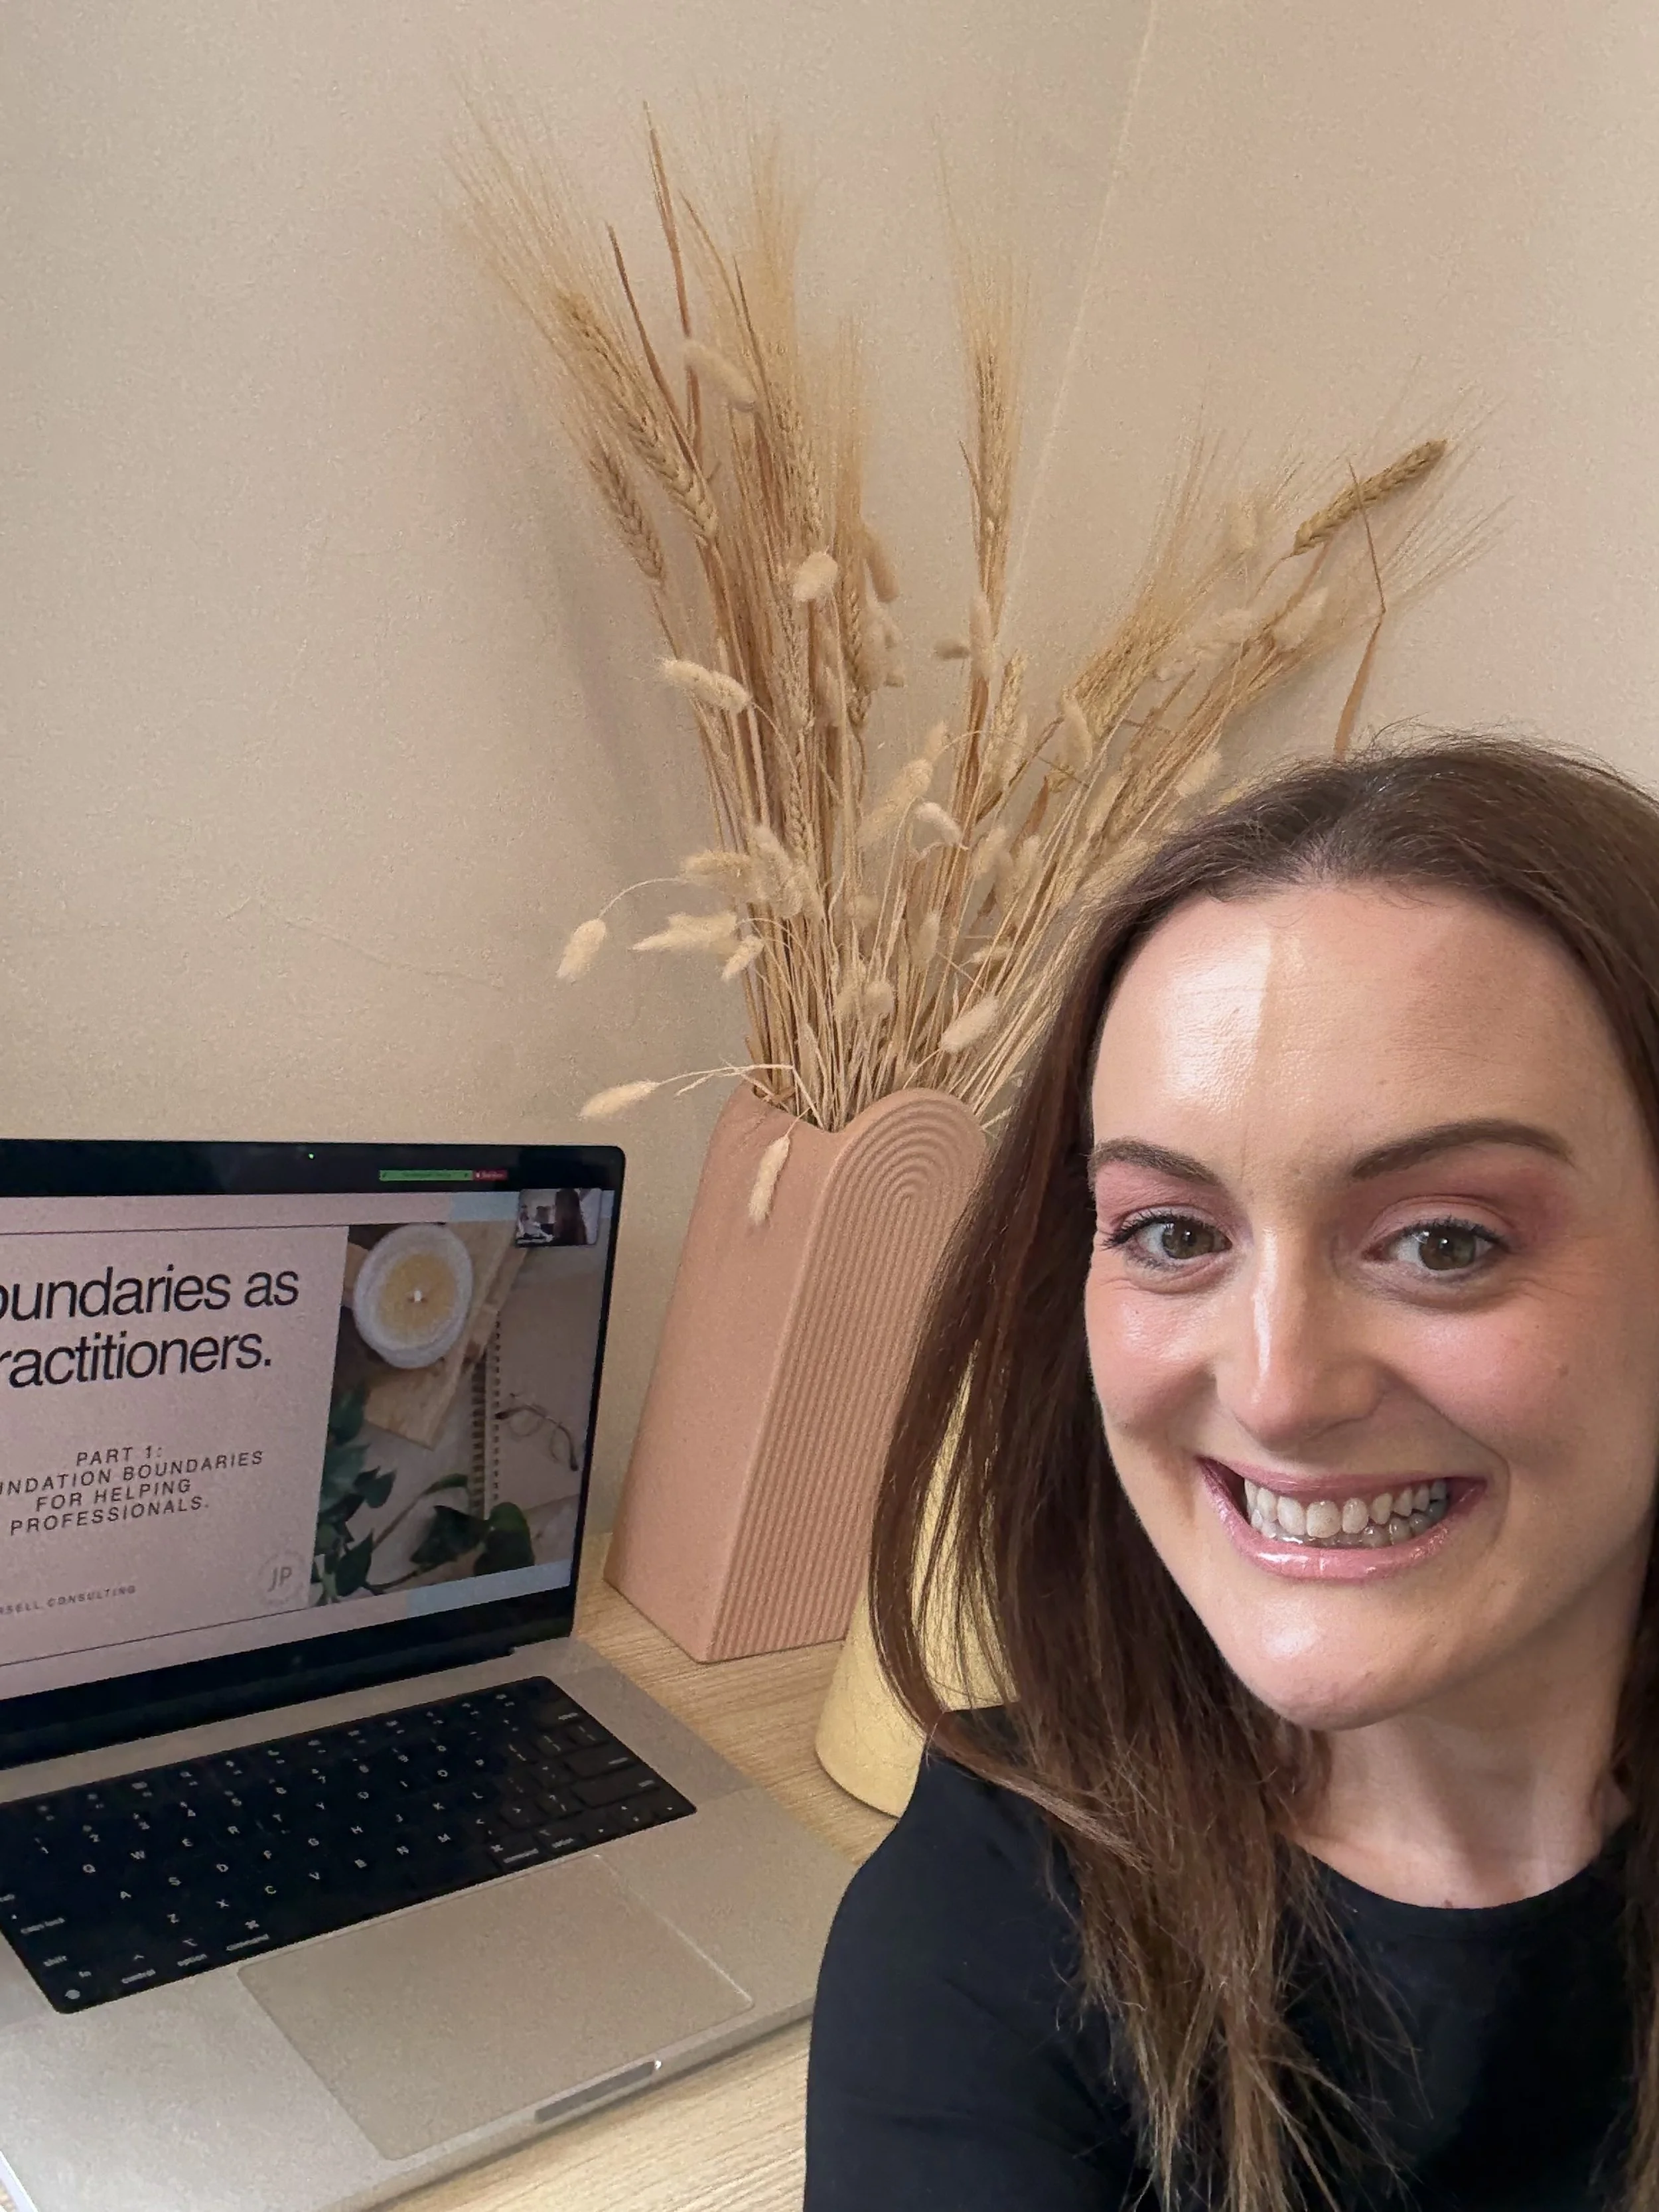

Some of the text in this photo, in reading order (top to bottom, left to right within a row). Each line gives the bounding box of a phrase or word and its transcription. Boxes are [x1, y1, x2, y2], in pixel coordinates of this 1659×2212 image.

[244, 1270, 299, 1307] as
[76, 1445, 163, 1466] PART 1:
[0, 1450, 263, 1495] NDATION BOUNDARIES
[35, 1479, 191, 1512] FOR HELPING
[11, 1496, 210, 1536] PROFESSIONALS.
[267, 1566, 292, 1592] JP
[46, 1585, 136, 1609] CONSULTING
